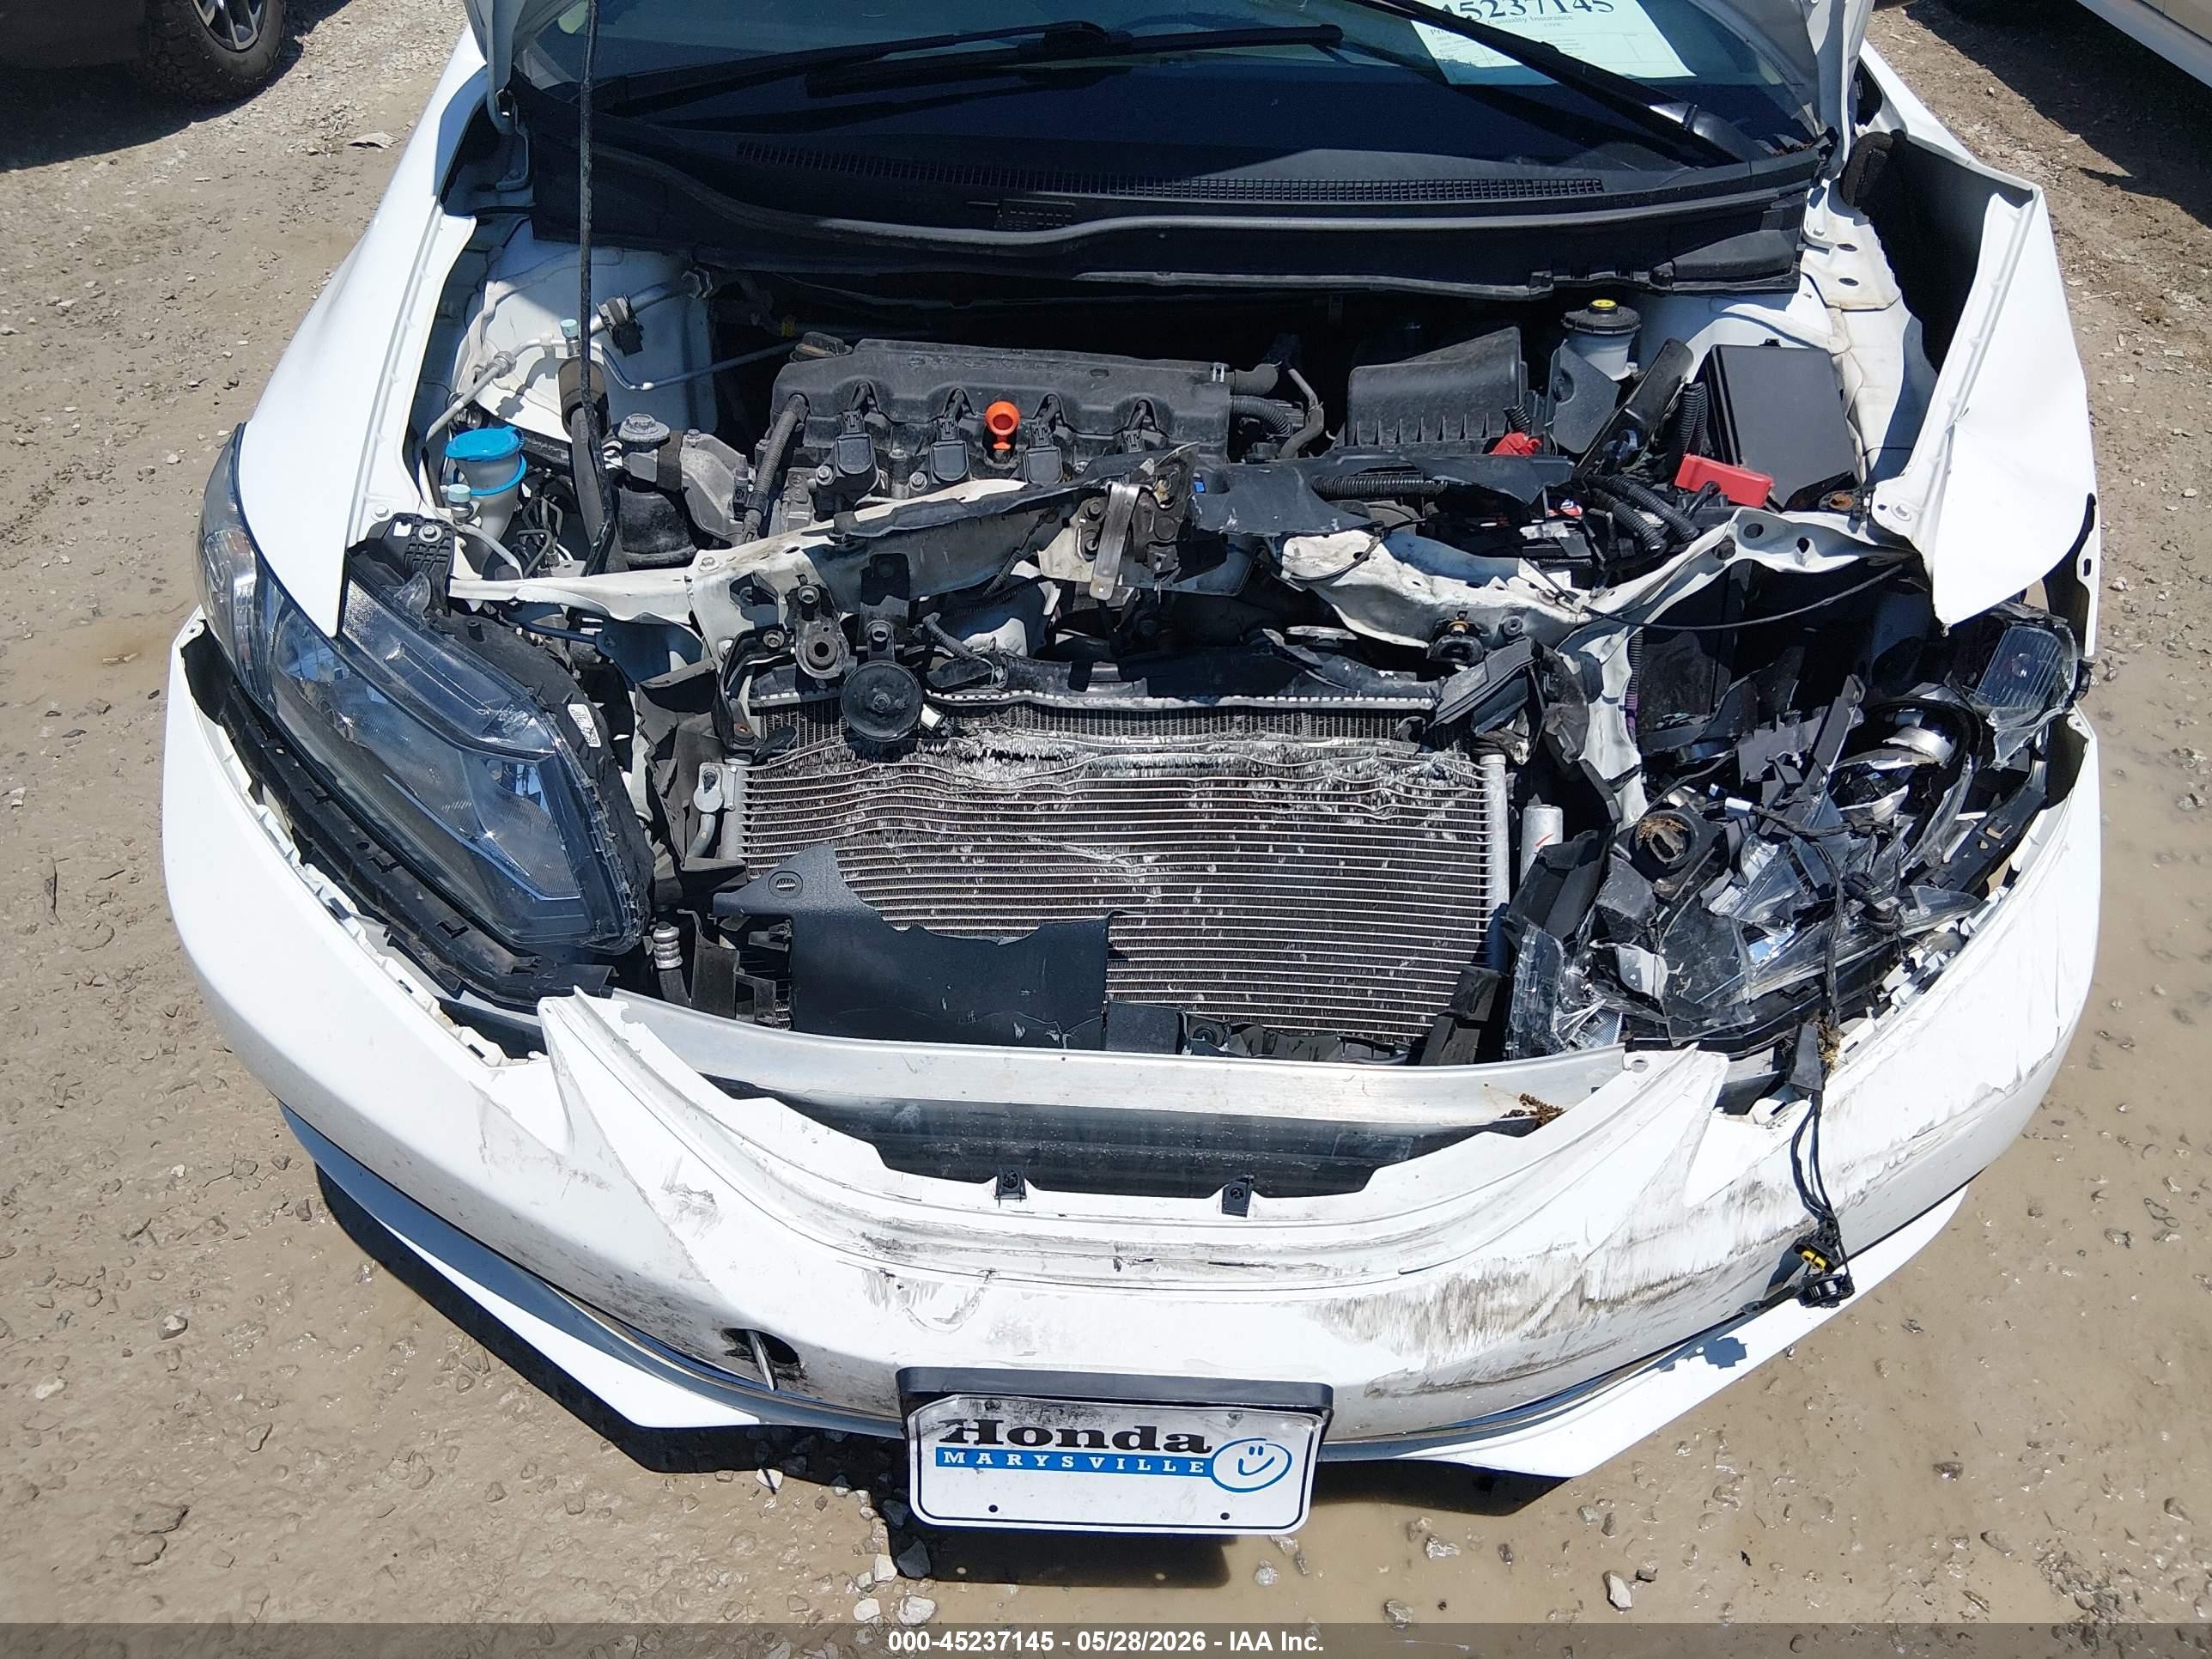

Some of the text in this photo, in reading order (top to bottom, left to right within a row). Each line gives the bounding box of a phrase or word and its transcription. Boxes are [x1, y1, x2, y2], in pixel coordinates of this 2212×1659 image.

[1487, 15, 1574, 26] Casualty Insurance
[939, 1419, 1213, 1454] Honda
[943, 1451, 1204, 1474] MARYSVILLE
